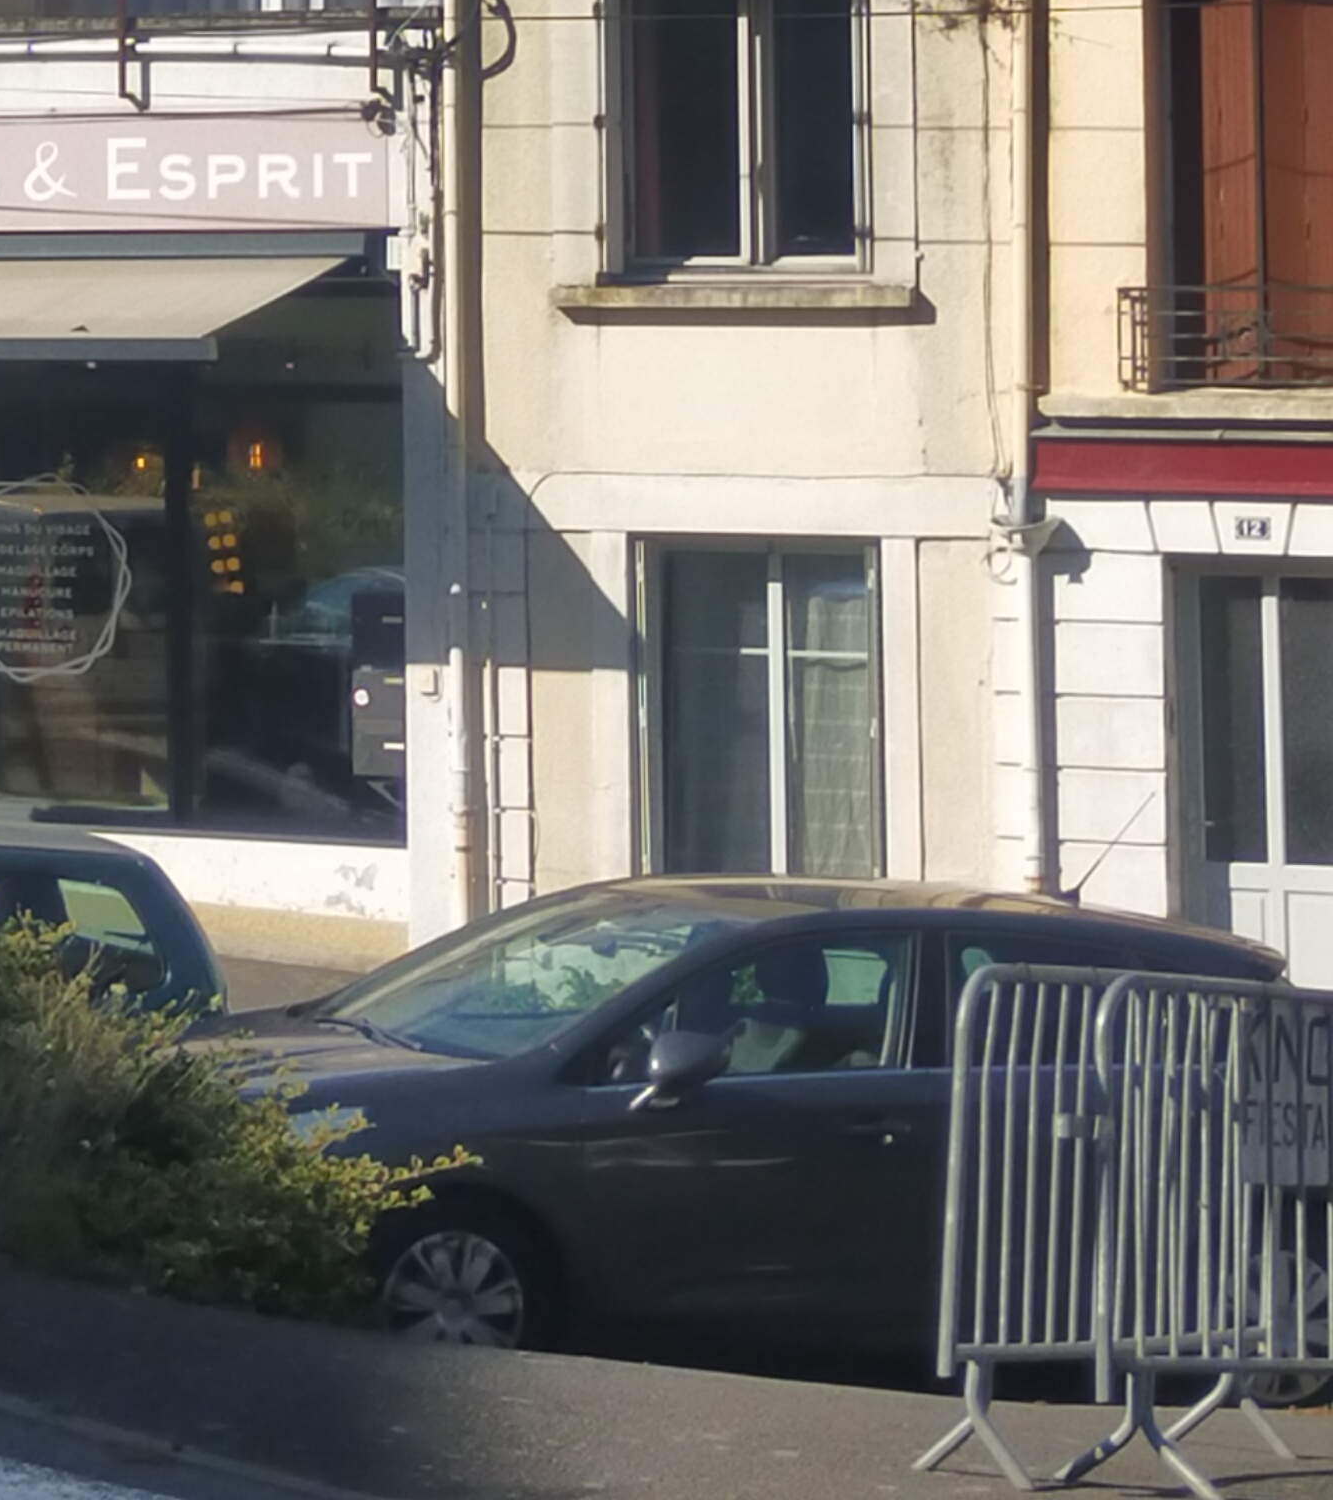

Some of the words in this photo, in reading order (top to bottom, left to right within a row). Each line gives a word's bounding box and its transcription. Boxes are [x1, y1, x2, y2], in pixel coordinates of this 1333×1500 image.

[23, 141, 78, 201] &
[1242, 519, 1262, 536] 12
[51, 546, 94, 556] CORPS
